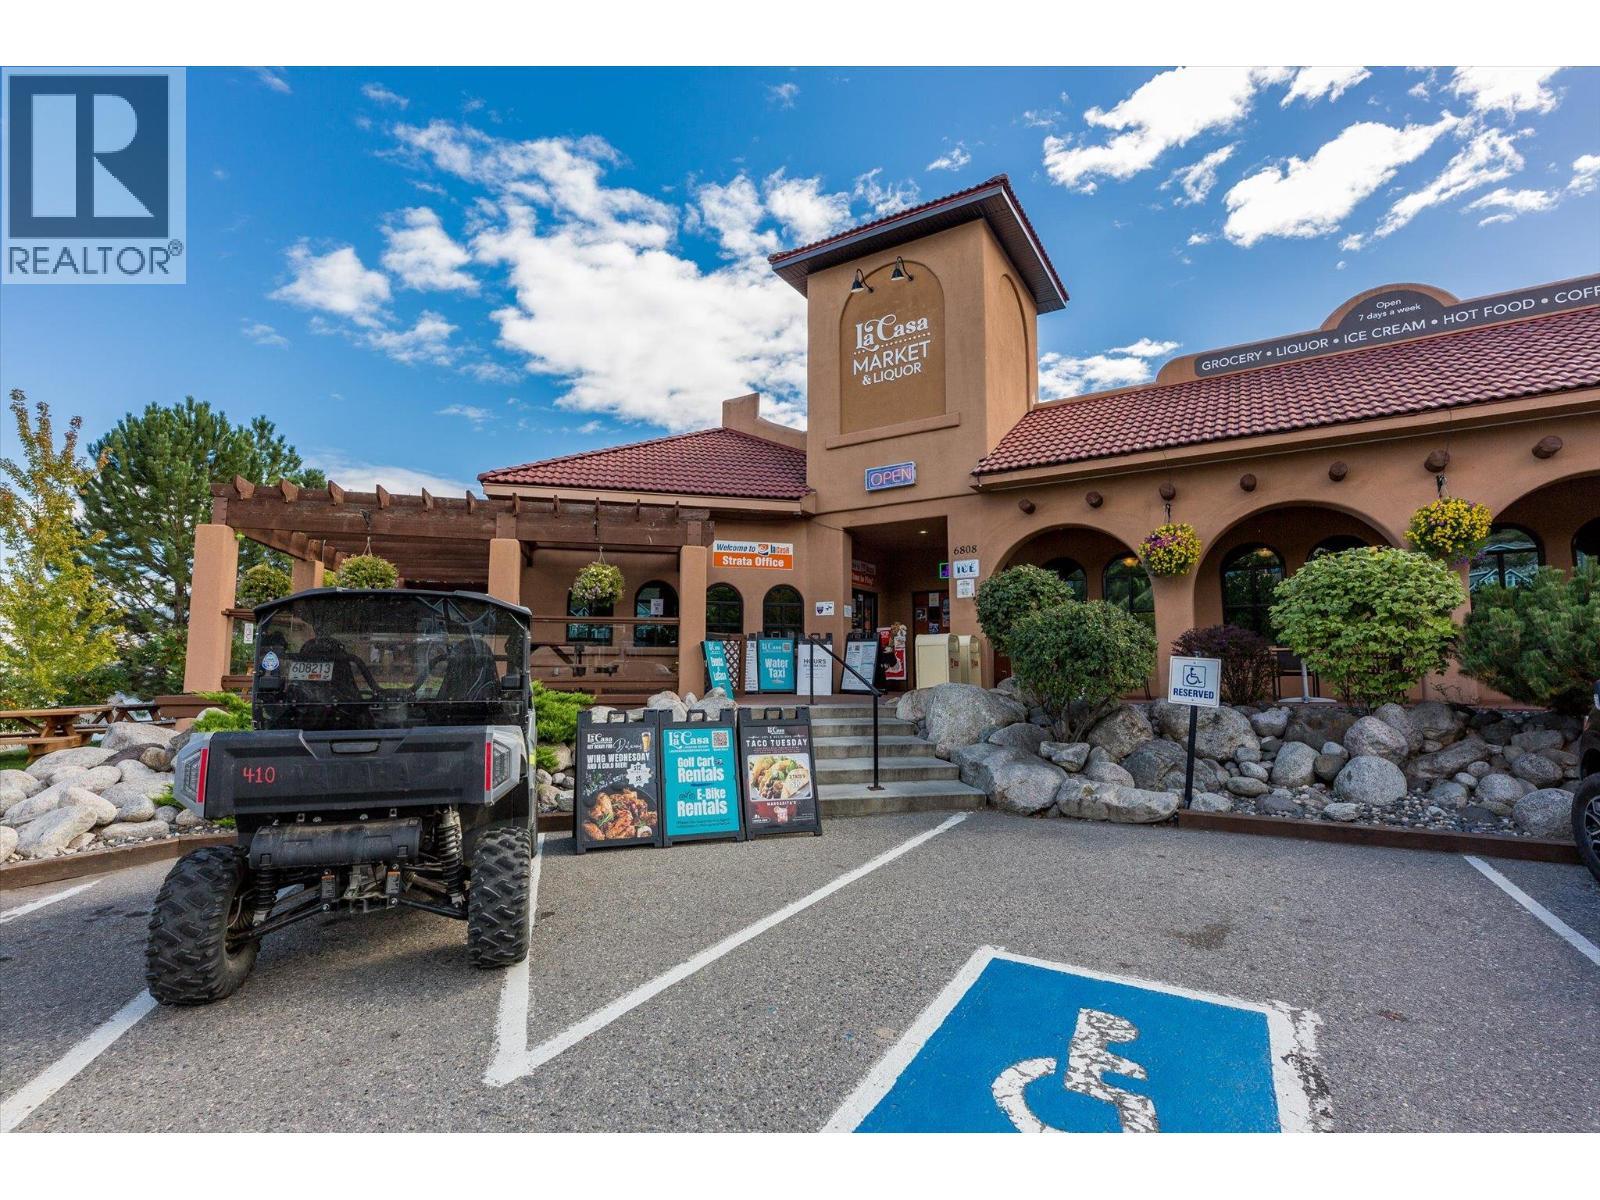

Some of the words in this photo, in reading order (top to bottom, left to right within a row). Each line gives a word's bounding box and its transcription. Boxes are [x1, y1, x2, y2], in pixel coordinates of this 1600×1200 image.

[1376, 299, 1402, 310] Open
[1367, 310, 1387, 320] days
[1397, 303, 1421, 314] week
[856, 319, 880, 352] La
[877, 314, 929, 341] Casa
[1201, 350, 1263, 371] GROCERY
[1276, 338, 1329, 357] LIQUOR
[1343, 330, 1367, 344] ICE
[1371, 319, 1426, 338] CREAM
[1443, 308, 1479, 325] HOT
[1484, 298, 1535, 317] FOOD
[853, 340, 931, 376] MARKET
[862, 374, 872, 386] &
[873, 362, 922, 384] LIQUOR
[870, 467, 913, 488] OPEN
[716, 543, 748, 552] Welcome
[748, 545, 756, 553] to
[953, 544, 977, 555] 6808
[722, 555, 753, 566] Strata
[755, 556, 785, 568] Office
[764, 658, 789, 668] Water
[768, 667, 786, 679] Taxi
[1173, 687, 1215, 700] RESERVED
[681, 730, 709, 745] Casa
[770, 738, 808, 747] TUESDAY
[586, 754, 606, 763] WING
[608, 752, 650, 763] WEDNESDAY
[677, 756, 695, 768] Golf
[696, 755, 715, 767] Cart
[240, 766, 276, 784] 410
[677, 766, 725, 783] Rentals
[696, 787, 727, 800] E-Bike
[677, 799, 728, 817] Rentals
